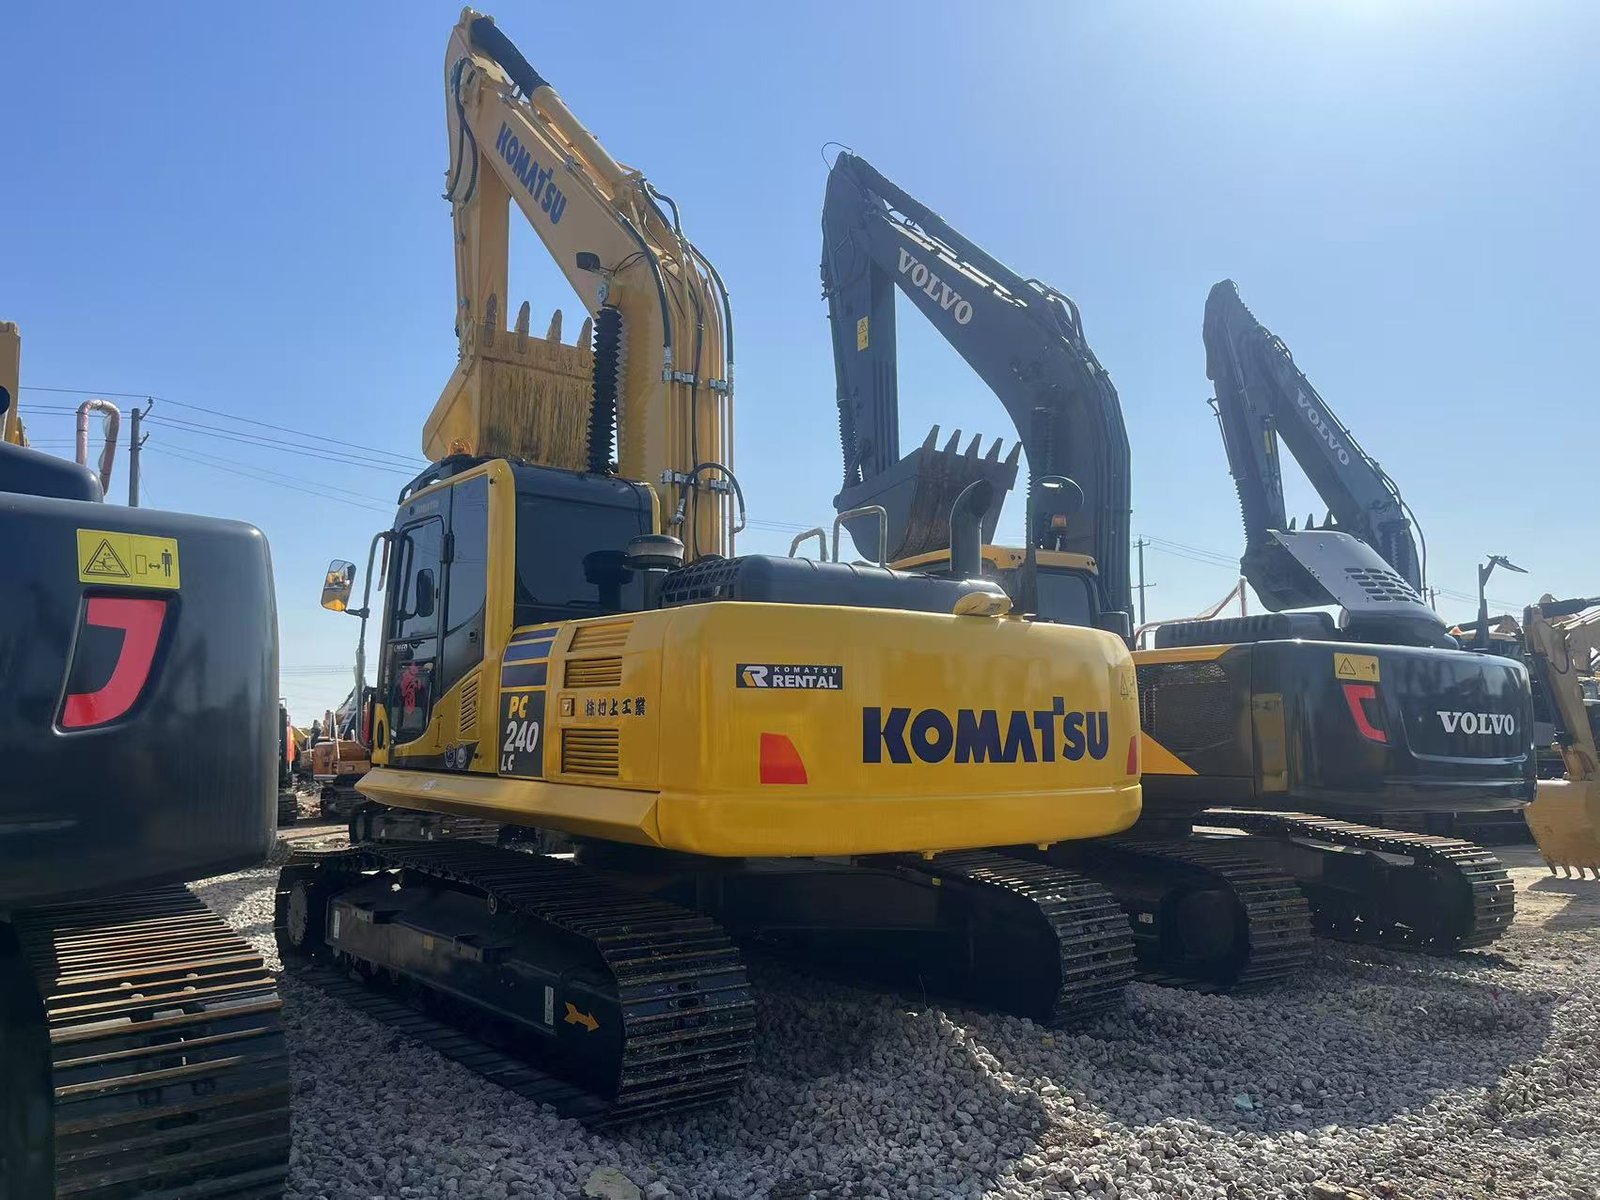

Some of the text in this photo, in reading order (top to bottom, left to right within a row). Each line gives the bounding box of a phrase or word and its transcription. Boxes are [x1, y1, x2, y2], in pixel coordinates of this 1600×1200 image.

[496, 121, 567, 224] KOMATSU
[898, 247, 973, 325] VOLVO
[1297, 387, 1350, 466] VOLVO
[772, 674, 838, 688] RENTAL
[774, 666, 837, 674] KOMATSU
[508, 695, 529, 719] PC
[503, 721, 540, 753] 240
[862, 696, 1109, 763] KOMATSU
[1436, 710, 1515, 736] VOLVO
[500, 753, 515, 771] LC
